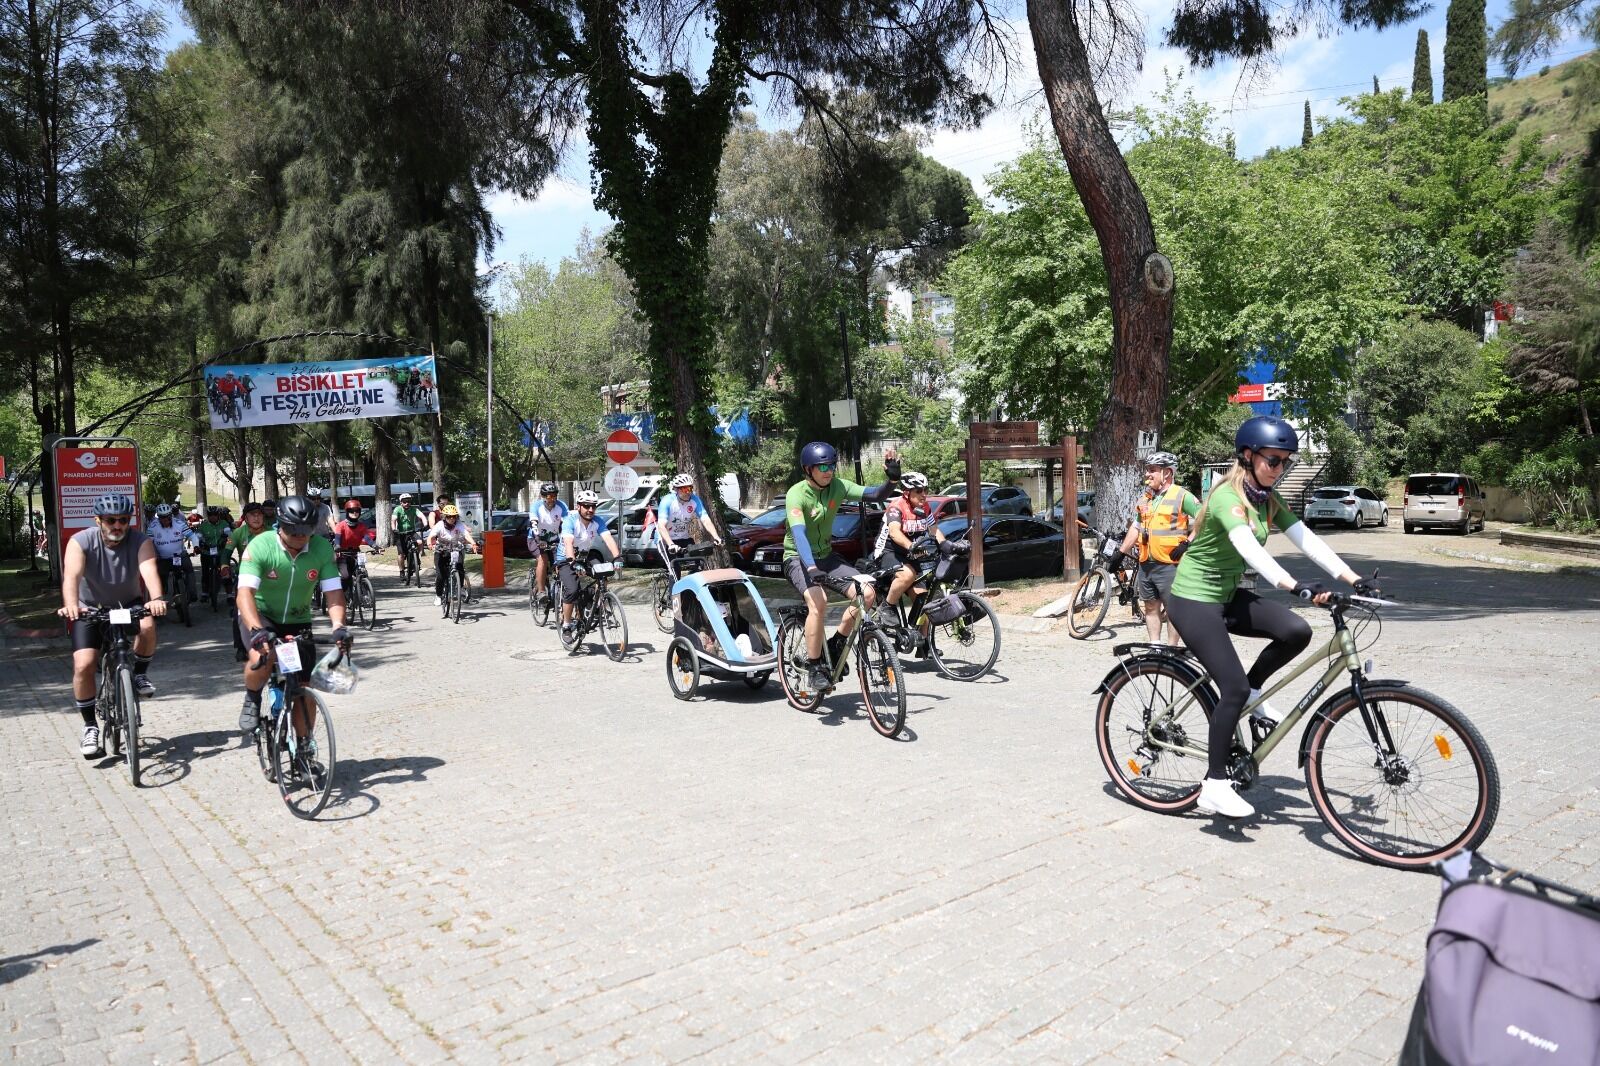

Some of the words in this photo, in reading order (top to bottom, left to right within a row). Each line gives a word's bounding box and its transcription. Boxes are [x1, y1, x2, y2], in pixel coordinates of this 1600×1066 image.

[276, 372, 366, 393] BİSİKLET
[316, 402, 362, 417] Geldiniz
[580, 481, 600, 493] WC
